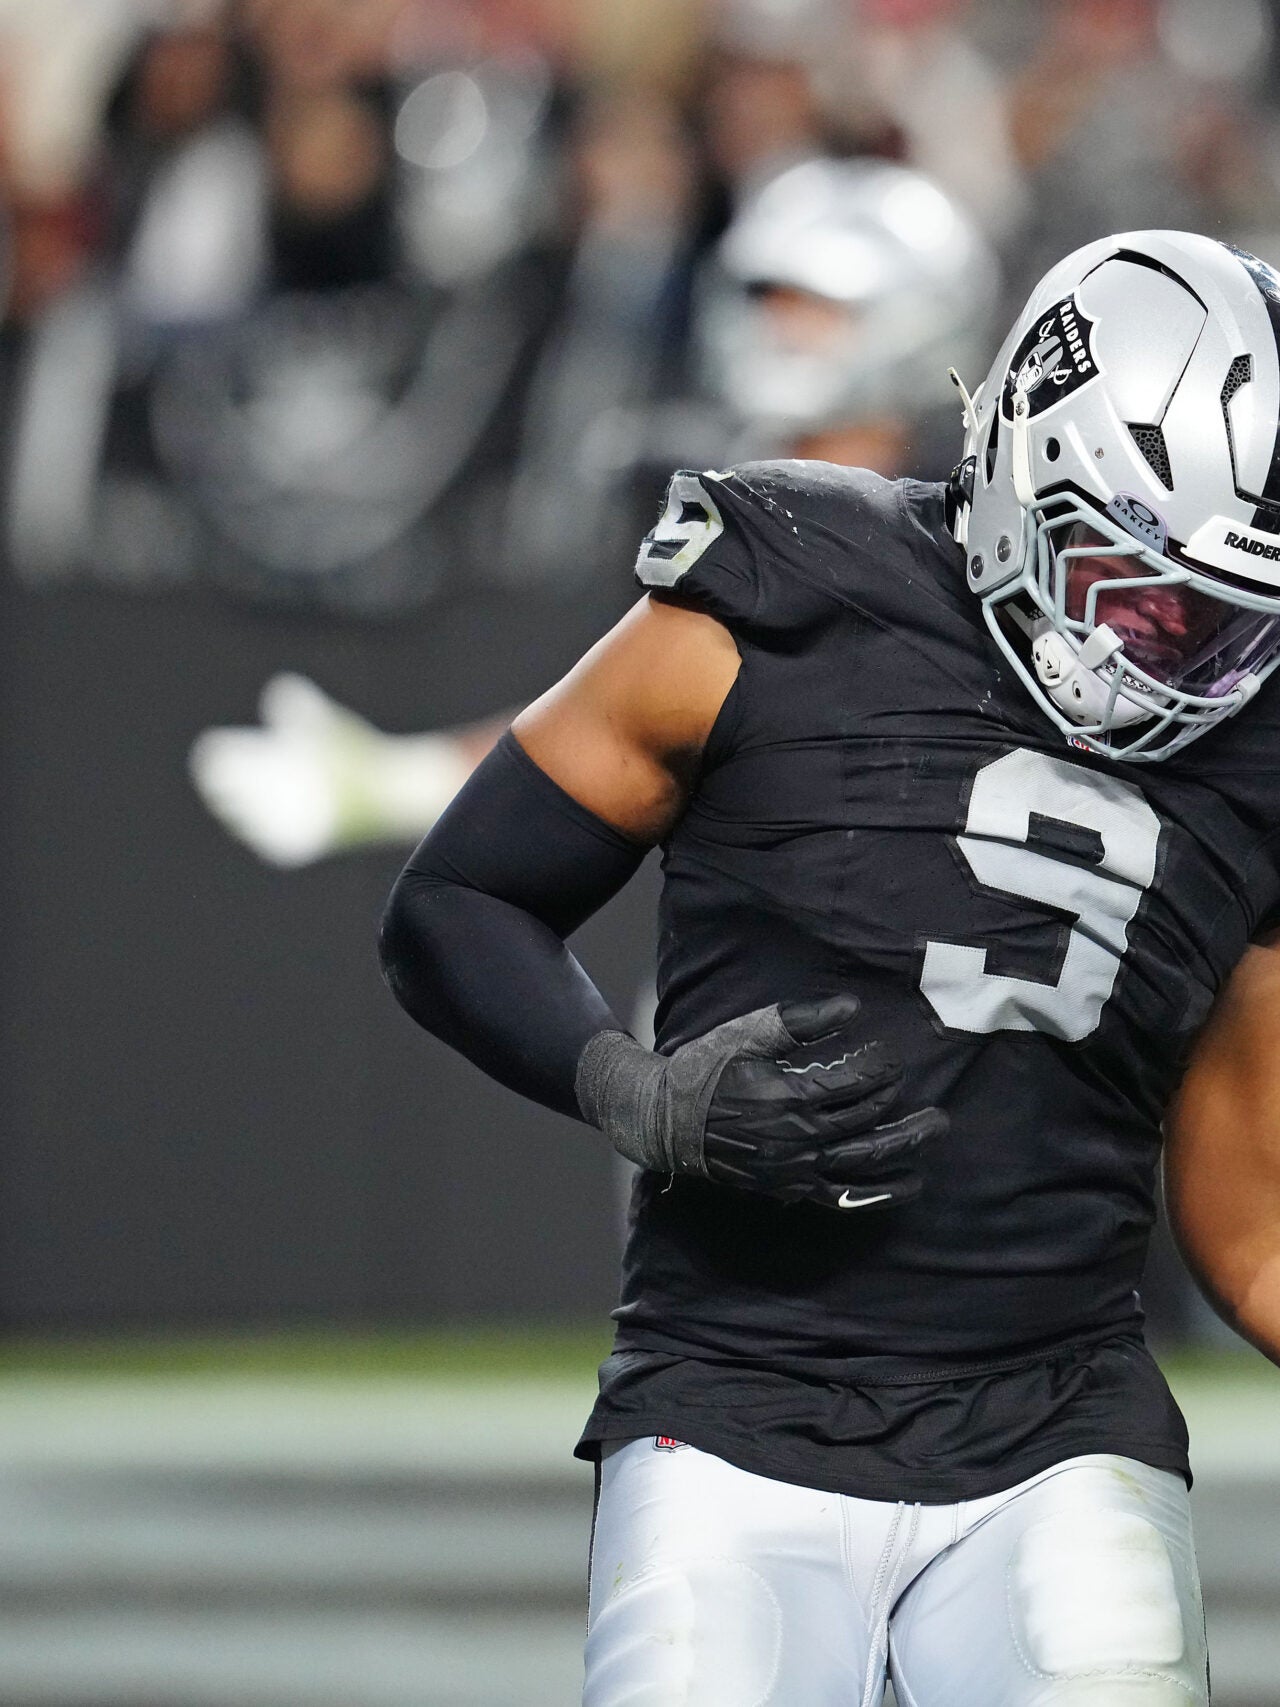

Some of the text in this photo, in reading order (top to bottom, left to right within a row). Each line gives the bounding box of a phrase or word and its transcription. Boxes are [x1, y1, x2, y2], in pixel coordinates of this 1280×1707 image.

[1059, 301, 1092, 373] RAIDERS
[635, 476, 724, 587] 9
[919, 748, 1160, 1042] 9
